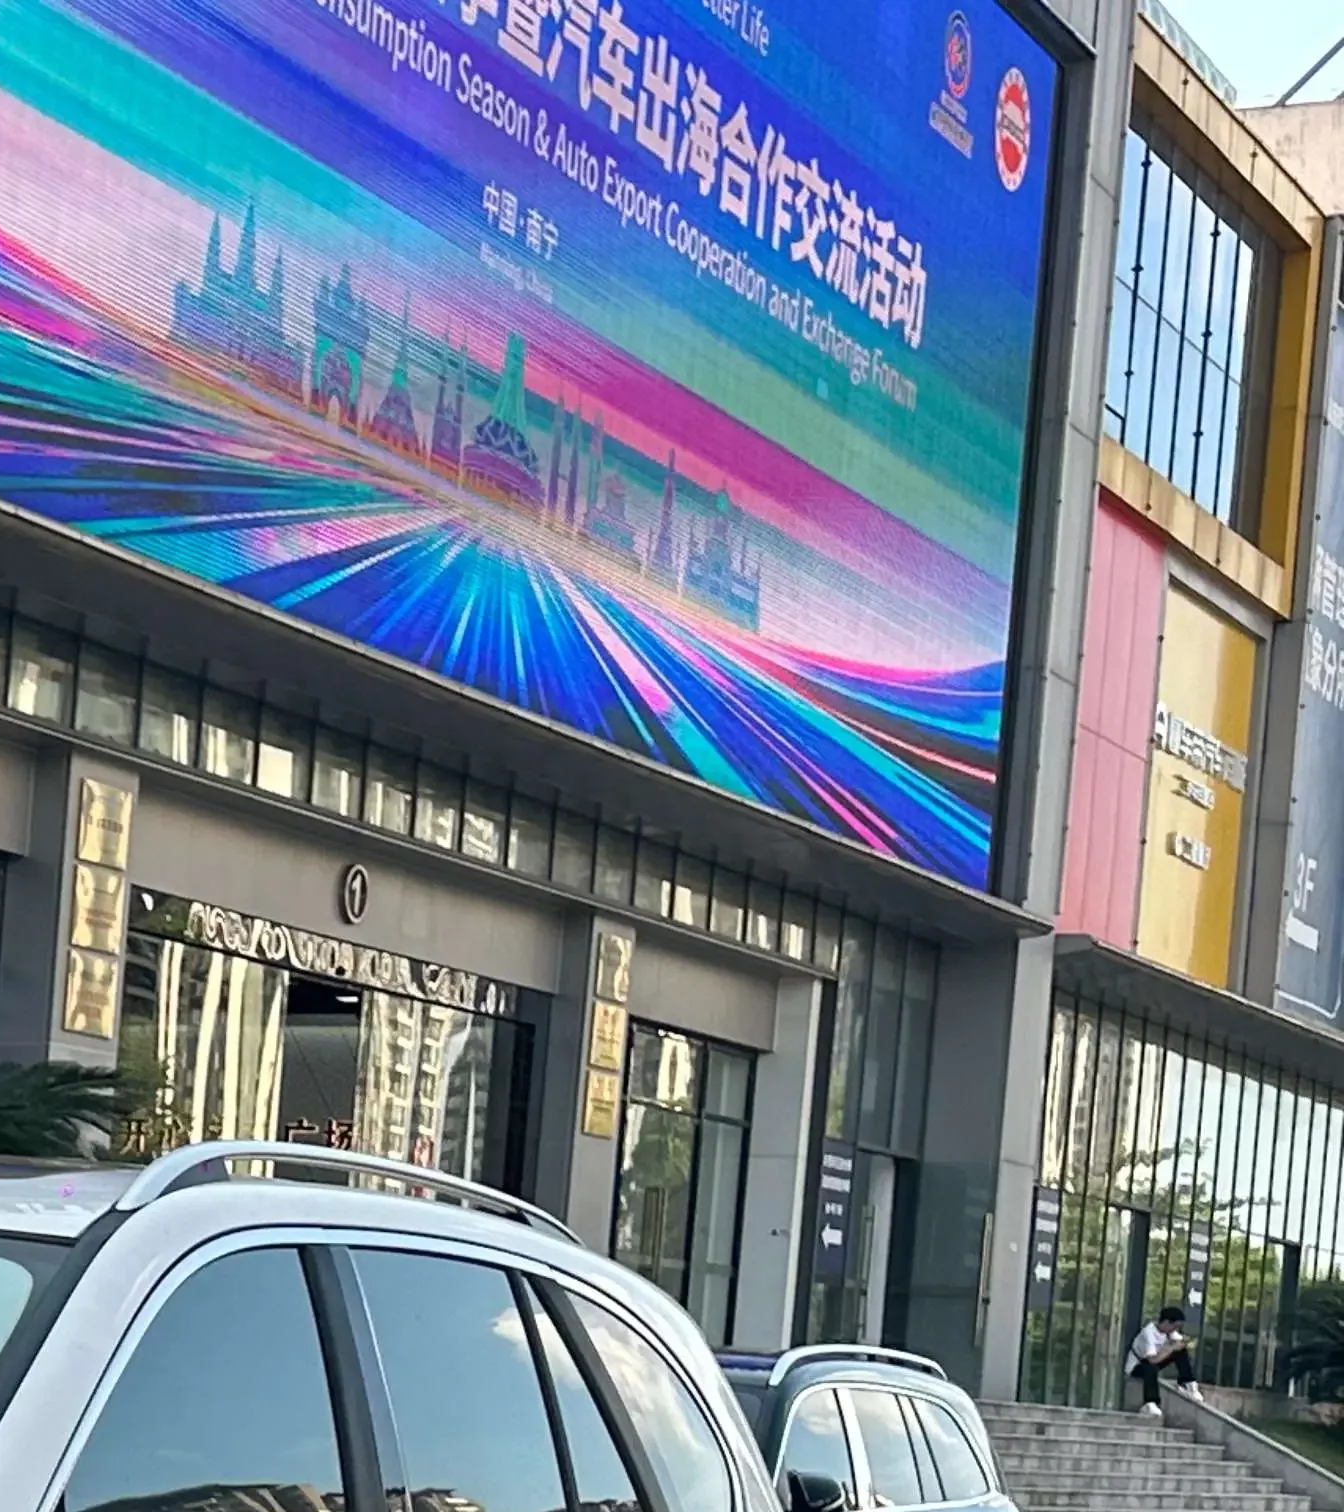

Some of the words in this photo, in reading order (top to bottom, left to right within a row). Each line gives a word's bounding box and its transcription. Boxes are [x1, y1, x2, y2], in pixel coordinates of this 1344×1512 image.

[740, 0, 770, 57] Life
[317, 0, 451, 92] sumption
[456, 53, 530, 147] Season
[533, 108, 551, 161] &
[552, 123, 599, 192] Auto
[603, 155, 663, 239] Export
[665, 201, 766, 310] Cooperation
[768, 281, 801, 334] and
[801, 297, 871, 386] Exchange
[871, 347, 918, 413] Forum
[1293, 852, 1317, 912] 3F
